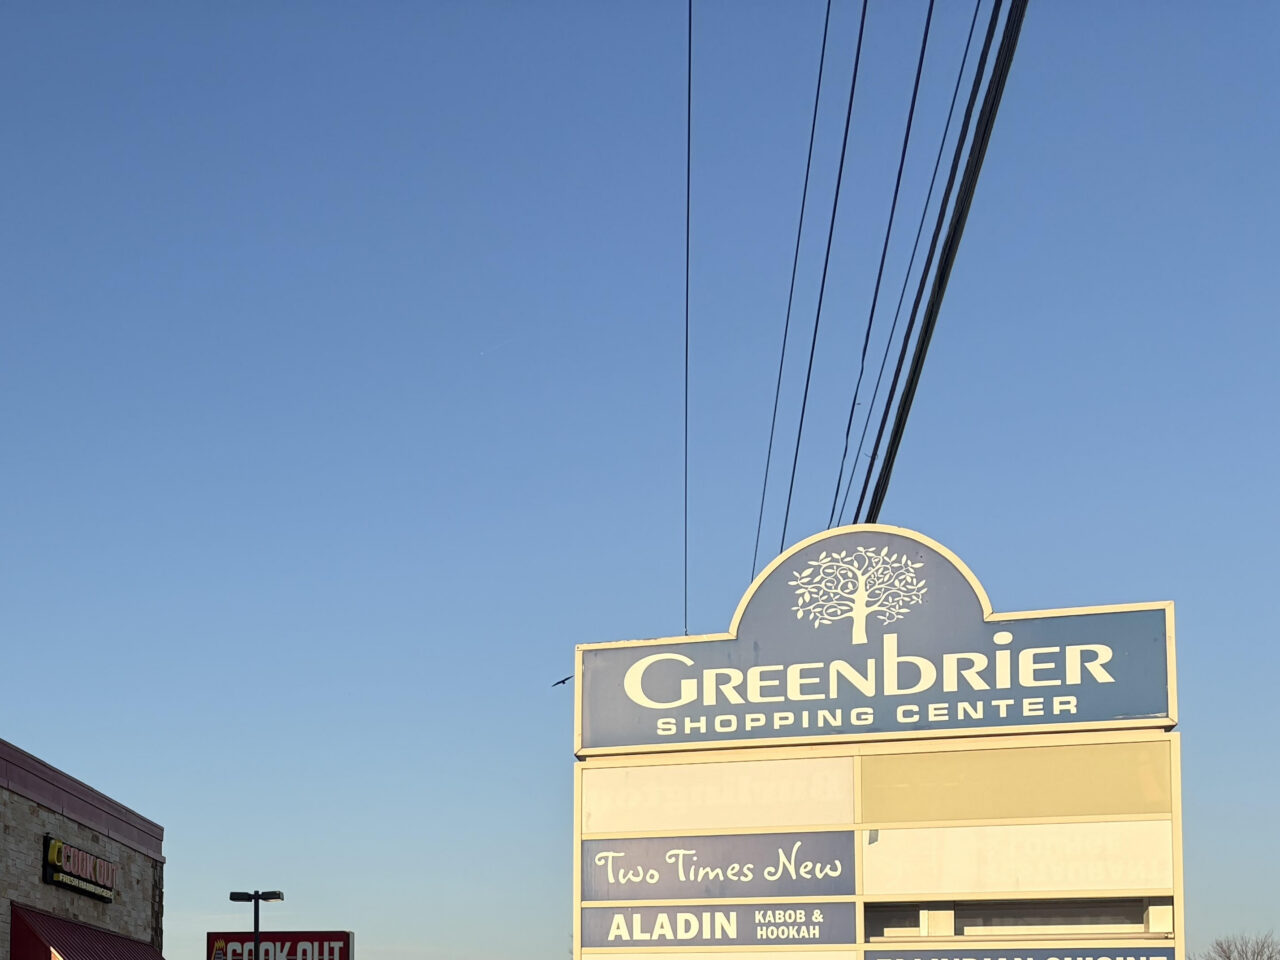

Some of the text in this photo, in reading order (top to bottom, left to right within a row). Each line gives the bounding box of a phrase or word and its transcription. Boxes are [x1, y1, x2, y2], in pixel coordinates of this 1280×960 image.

[656, 696, 1078, 736] SHOPPING CENTER
[62, 845, 96, 882] COOK
[595, 841, 843, 884] Two Times New
[608, 909, 824, 941] ALADIN KABOB &
[756, 924, 820, 940] HOOKAH
